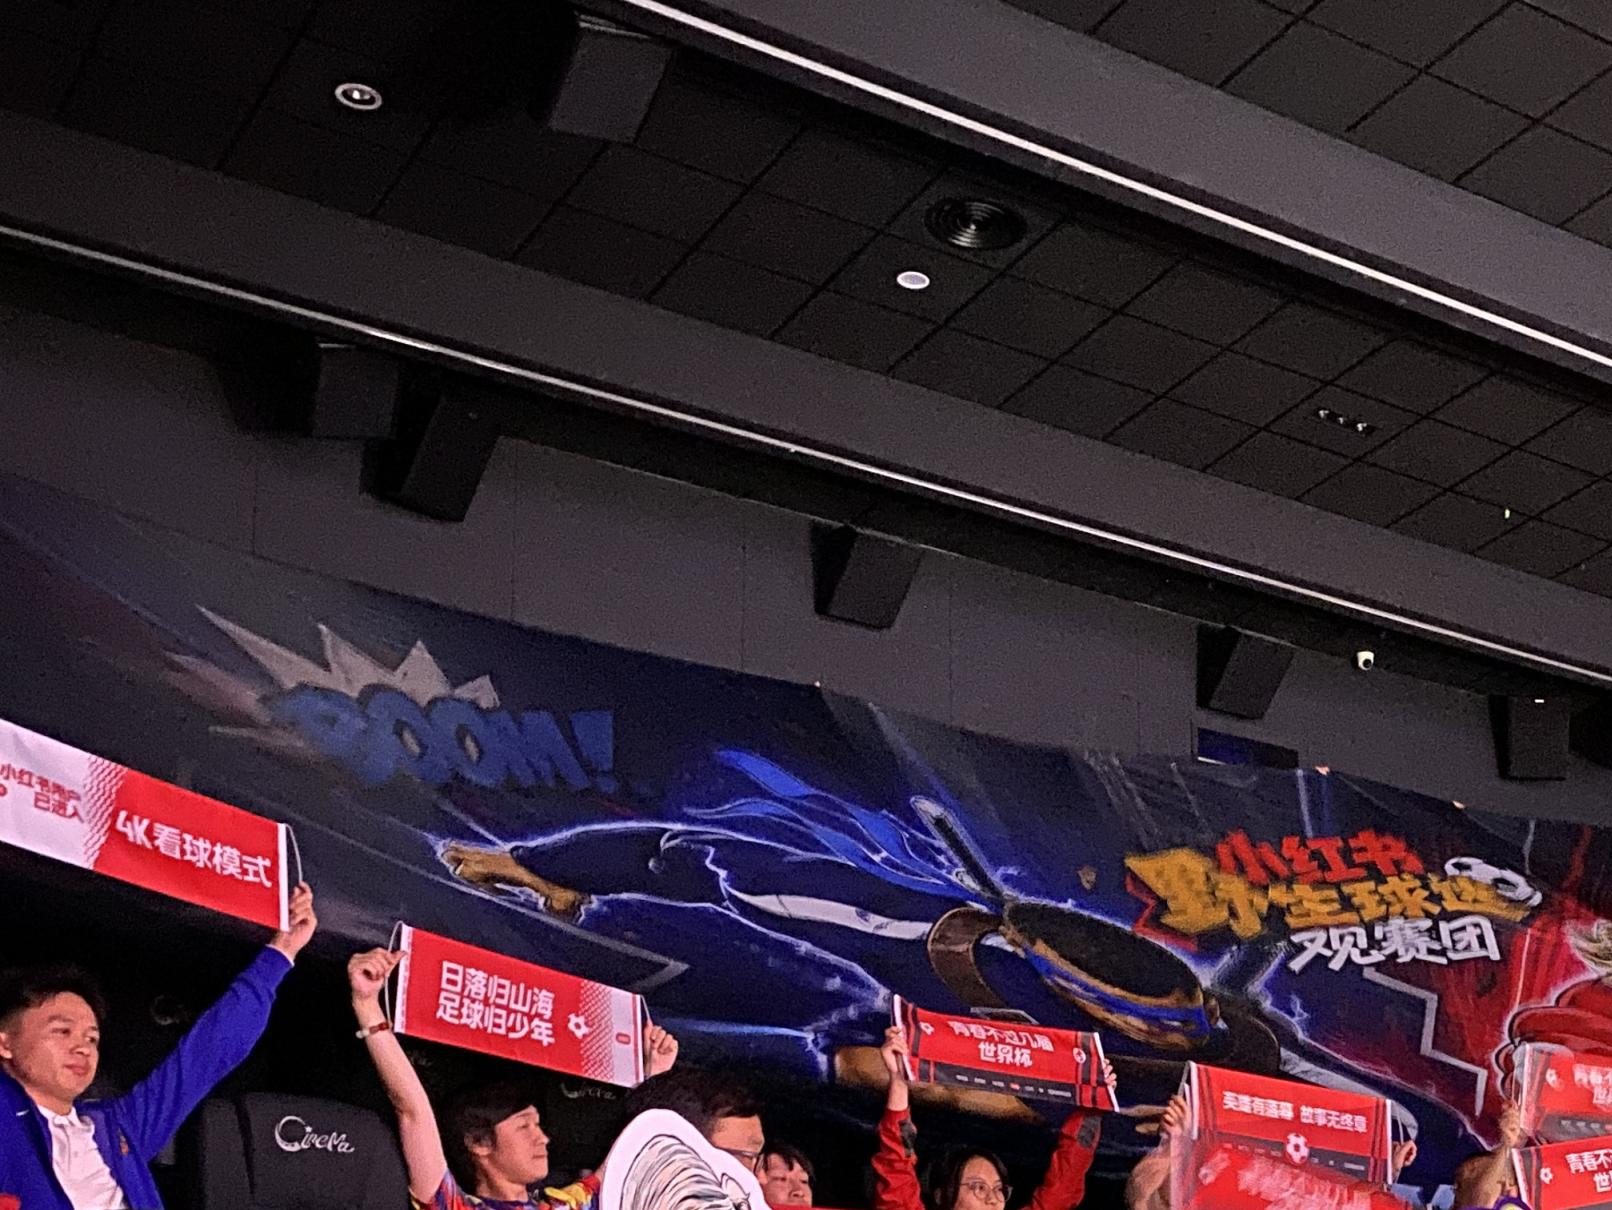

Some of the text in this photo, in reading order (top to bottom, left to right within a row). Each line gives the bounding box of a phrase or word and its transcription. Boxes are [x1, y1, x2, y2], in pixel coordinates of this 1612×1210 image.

[115, 810, 273, 888] 4K看球模式
[1217, 830, 1425, 884] 小红书
[1287, 916, 1500, 972] 观赛团
[441, 960, 555, 1019] 日落归山海
[436, 992, 555, 1047] 足球归少年
[947, 1021, 1054, 1051] 青春不过几届
[978, 1041, 1032, 1067] 世界杯
